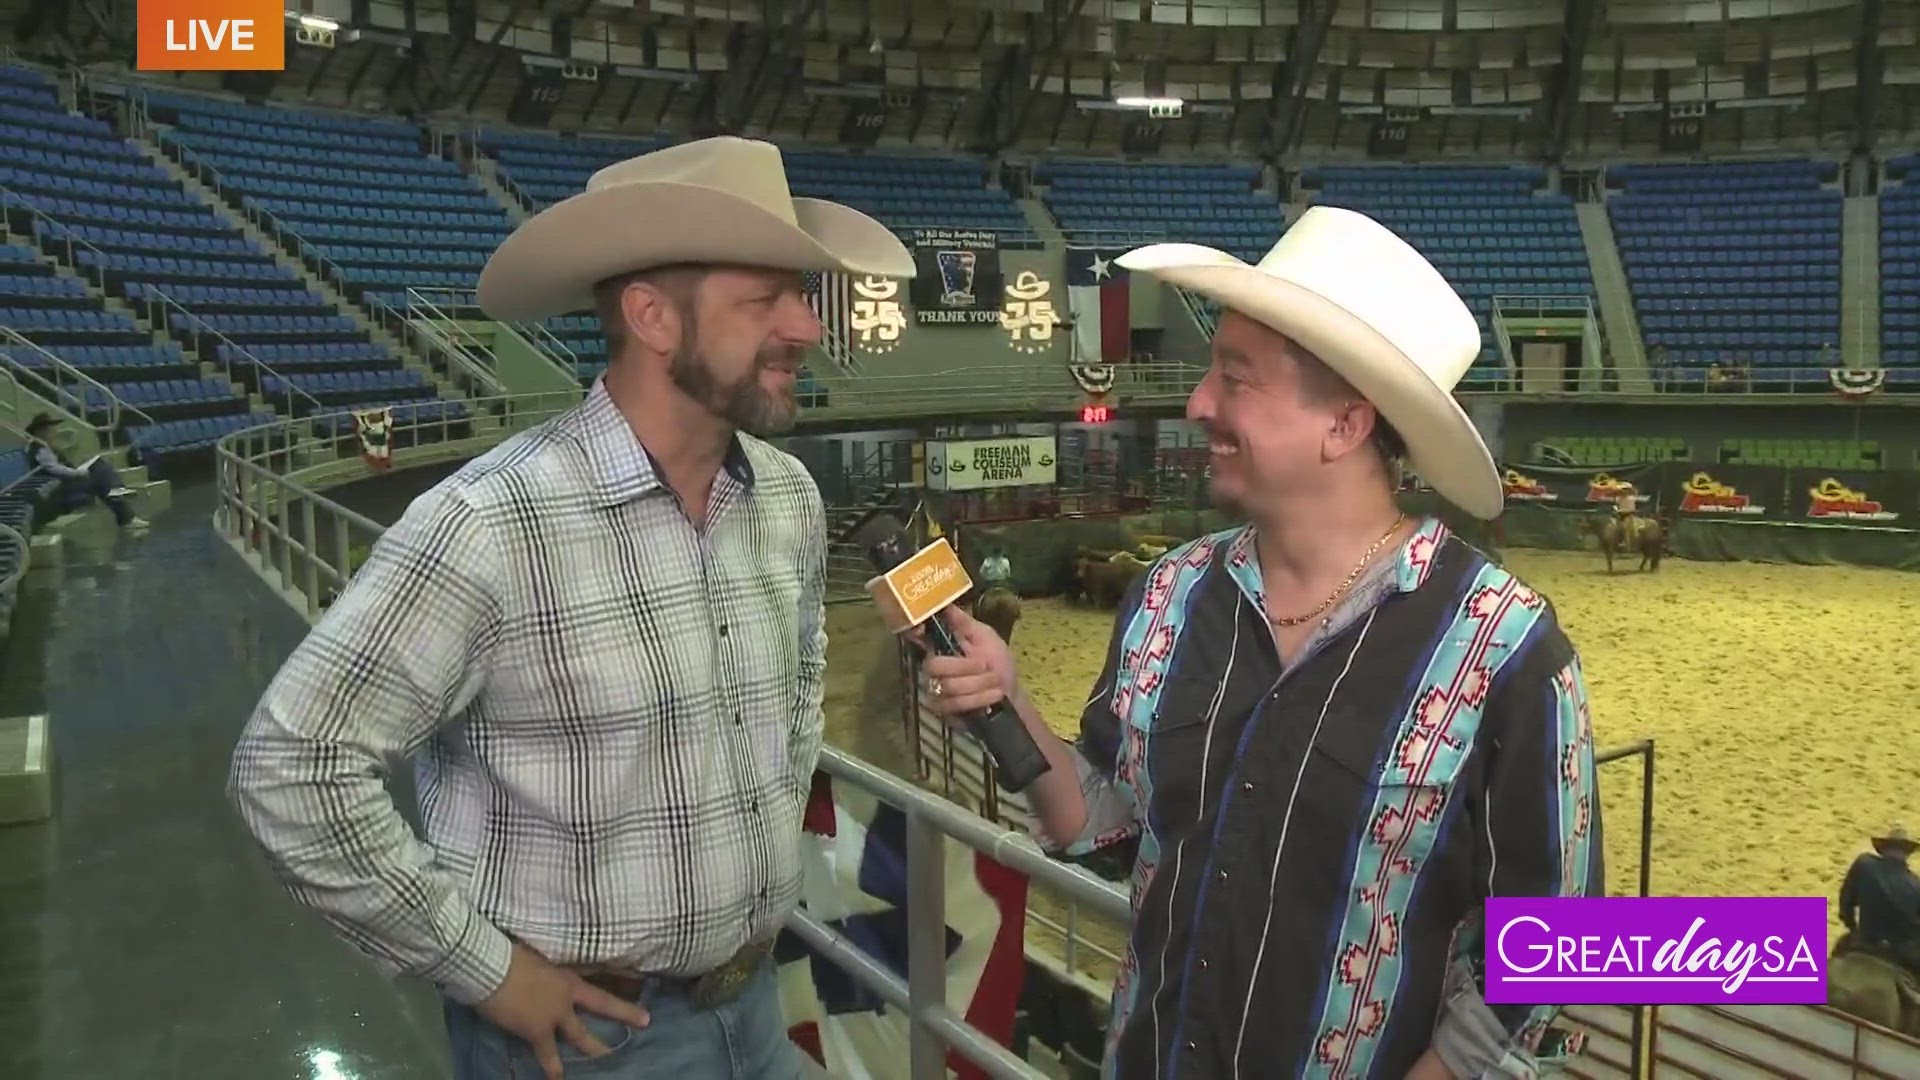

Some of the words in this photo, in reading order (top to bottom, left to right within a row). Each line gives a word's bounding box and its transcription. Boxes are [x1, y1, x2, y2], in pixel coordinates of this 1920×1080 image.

[855, 112, 885, 127] 116
[926, 230, 938, 238] All
[852, 301, 907, 340] 75
[918, 311, 966, 322] THANK
[1001, 301, 1061, 340] 75
[973, 445, 1030, 458] FREEMAN
[973, 456, 1031, 470] COLISEUM
[982, 467, 1023, 481] ARENA
